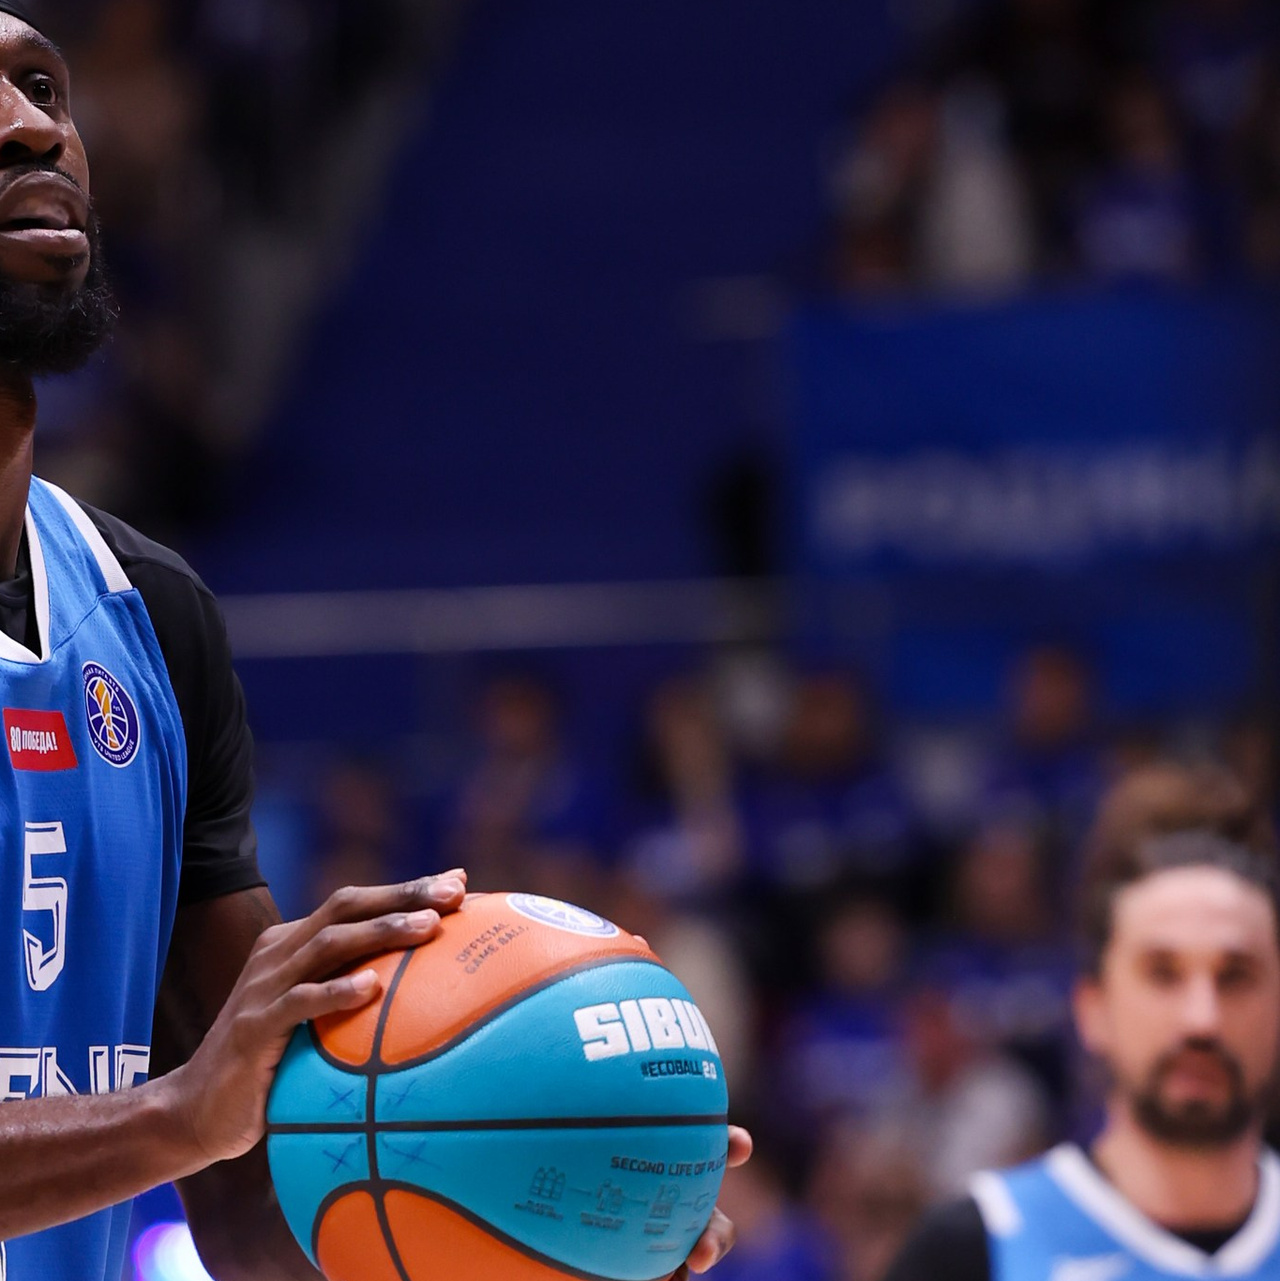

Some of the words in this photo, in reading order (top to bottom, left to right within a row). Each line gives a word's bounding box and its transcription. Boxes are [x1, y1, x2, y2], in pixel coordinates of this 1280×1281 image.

[10, 726, 22, 752] 80
[22, 730, 58, 755] ПОБЕДА!
[23, 821, 68, 991] 5
[610, 1156, 665, 1176] SECOND
[668, 1163, 692, 1176] LIFE
[694, 1162, 707, 1176] OF
